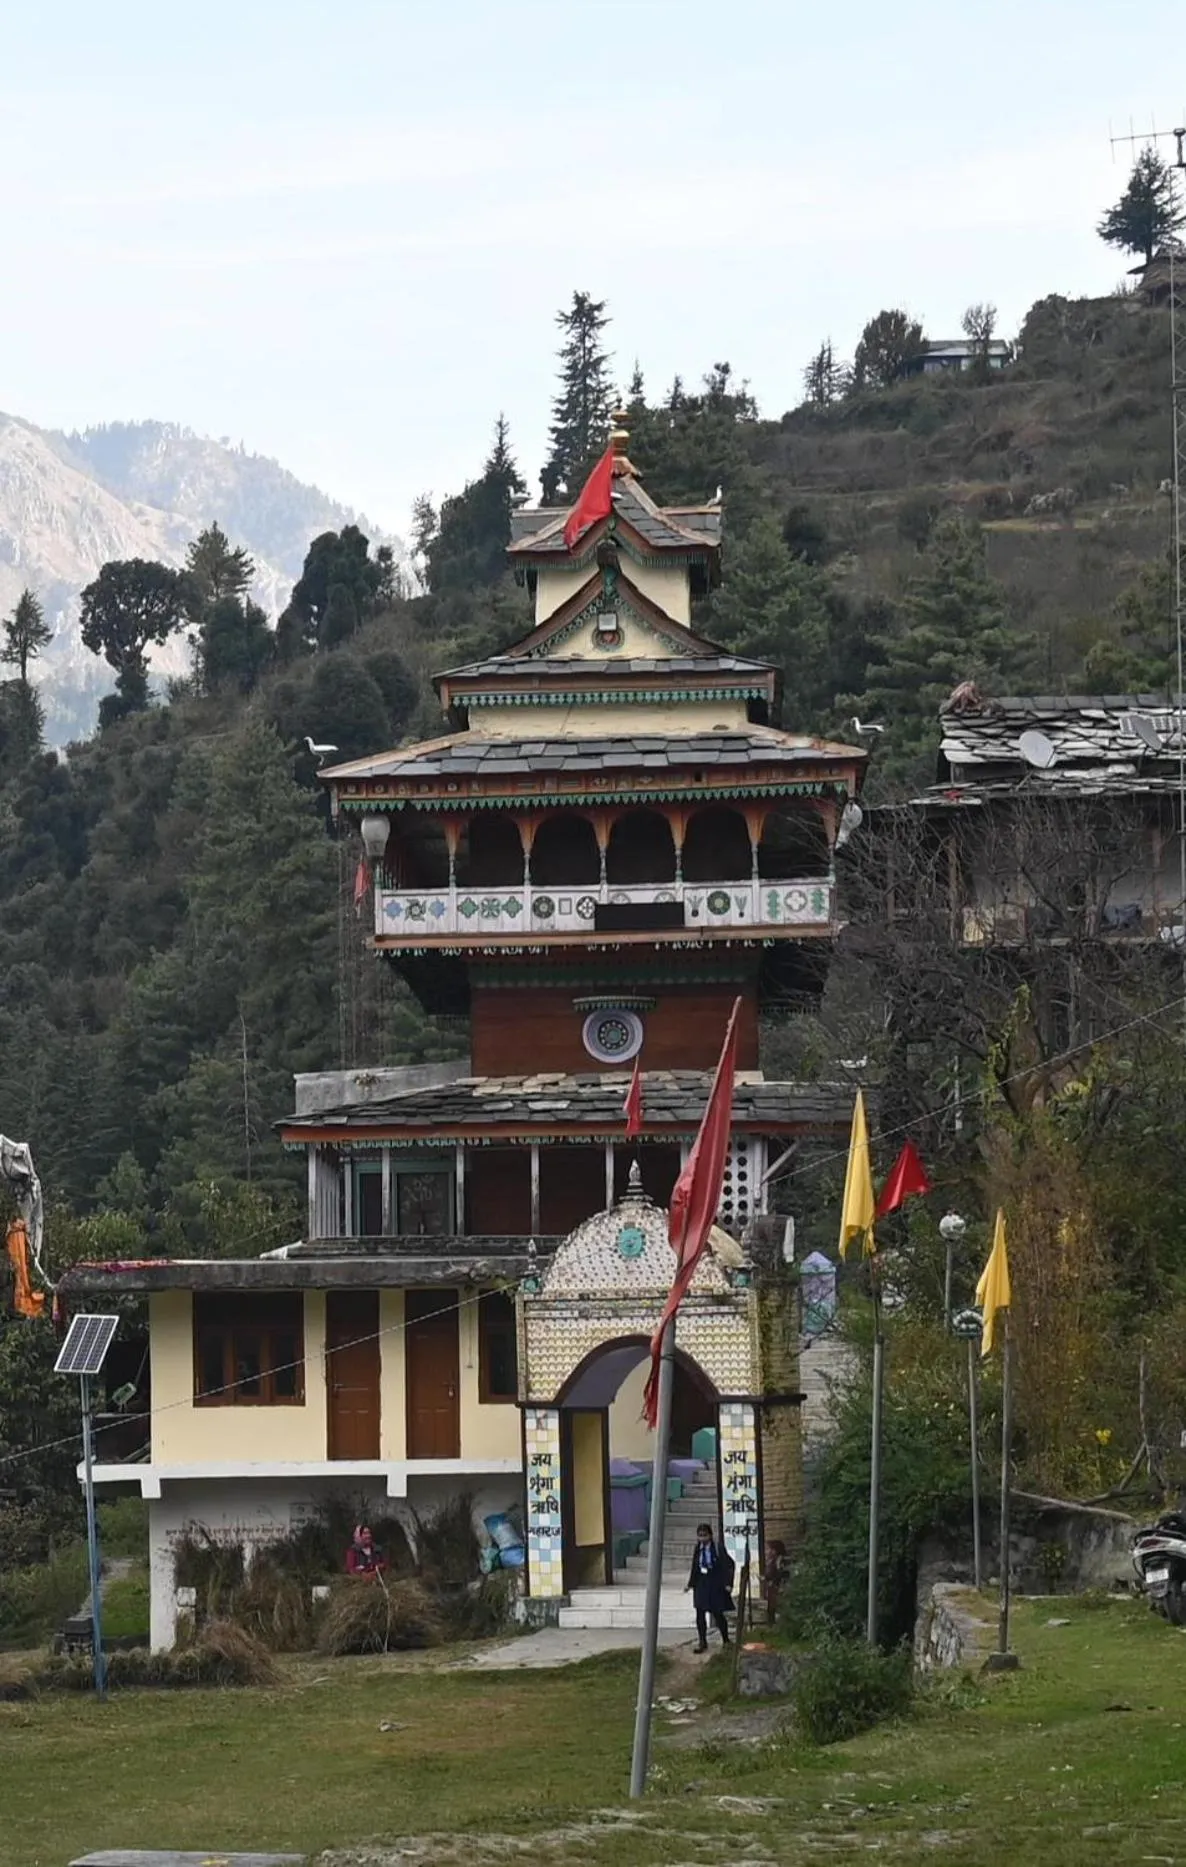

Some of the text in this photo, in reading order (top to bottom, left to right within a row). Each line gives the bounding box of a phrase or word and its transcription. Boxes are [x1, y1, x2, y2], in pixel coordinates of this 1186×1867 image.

[531, 1452, 552, 1467] जय
[724, 1450, 748, 1464] जय
[531, 1495, 559, 1514] ऋषि
